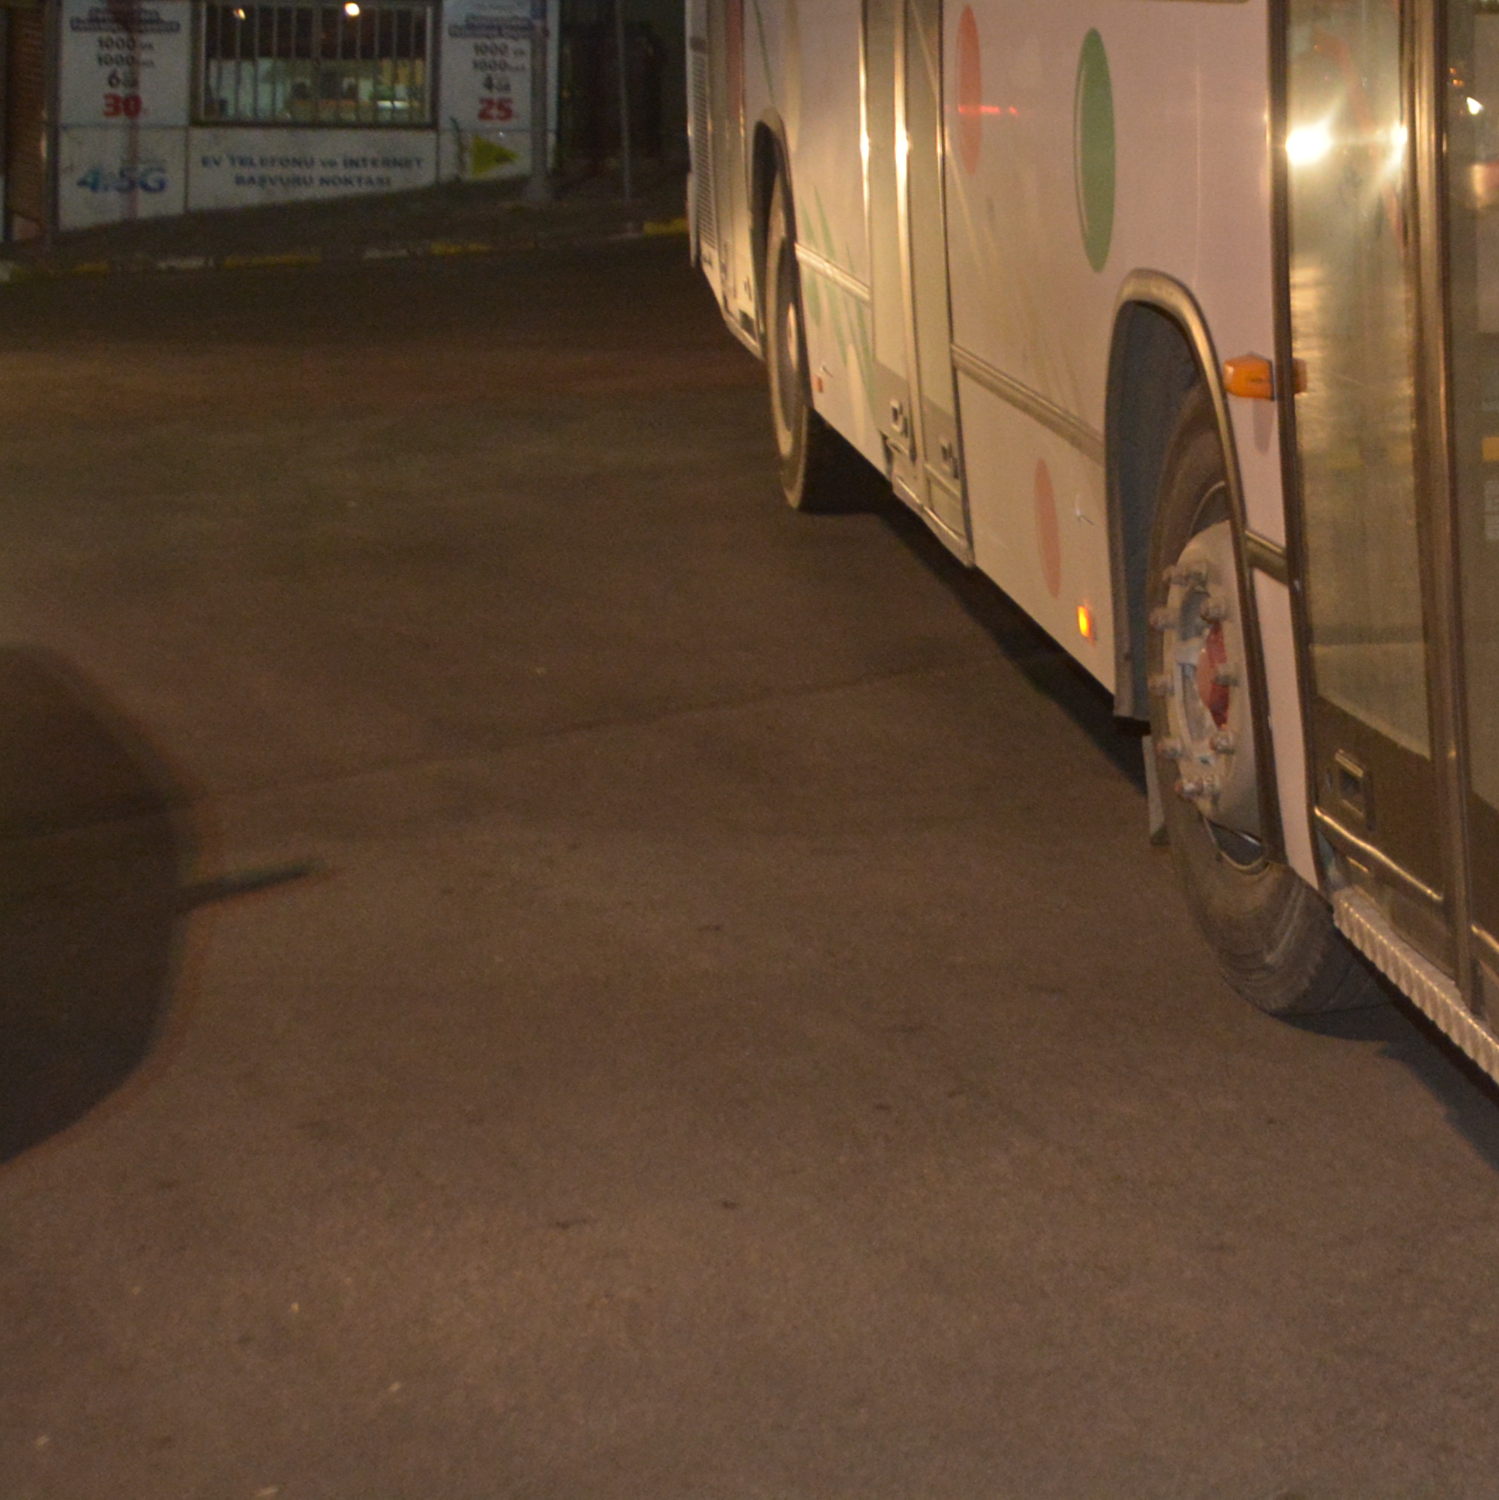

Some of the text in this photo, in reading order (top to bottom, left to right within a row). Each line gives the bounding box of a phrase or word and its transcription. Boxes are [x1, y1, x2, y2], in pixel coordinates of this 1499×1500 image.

[103, 92, 143, 119] 30
[478, 97, 514, 121] 25
[226, 154, 315, 168] TELEFONU
